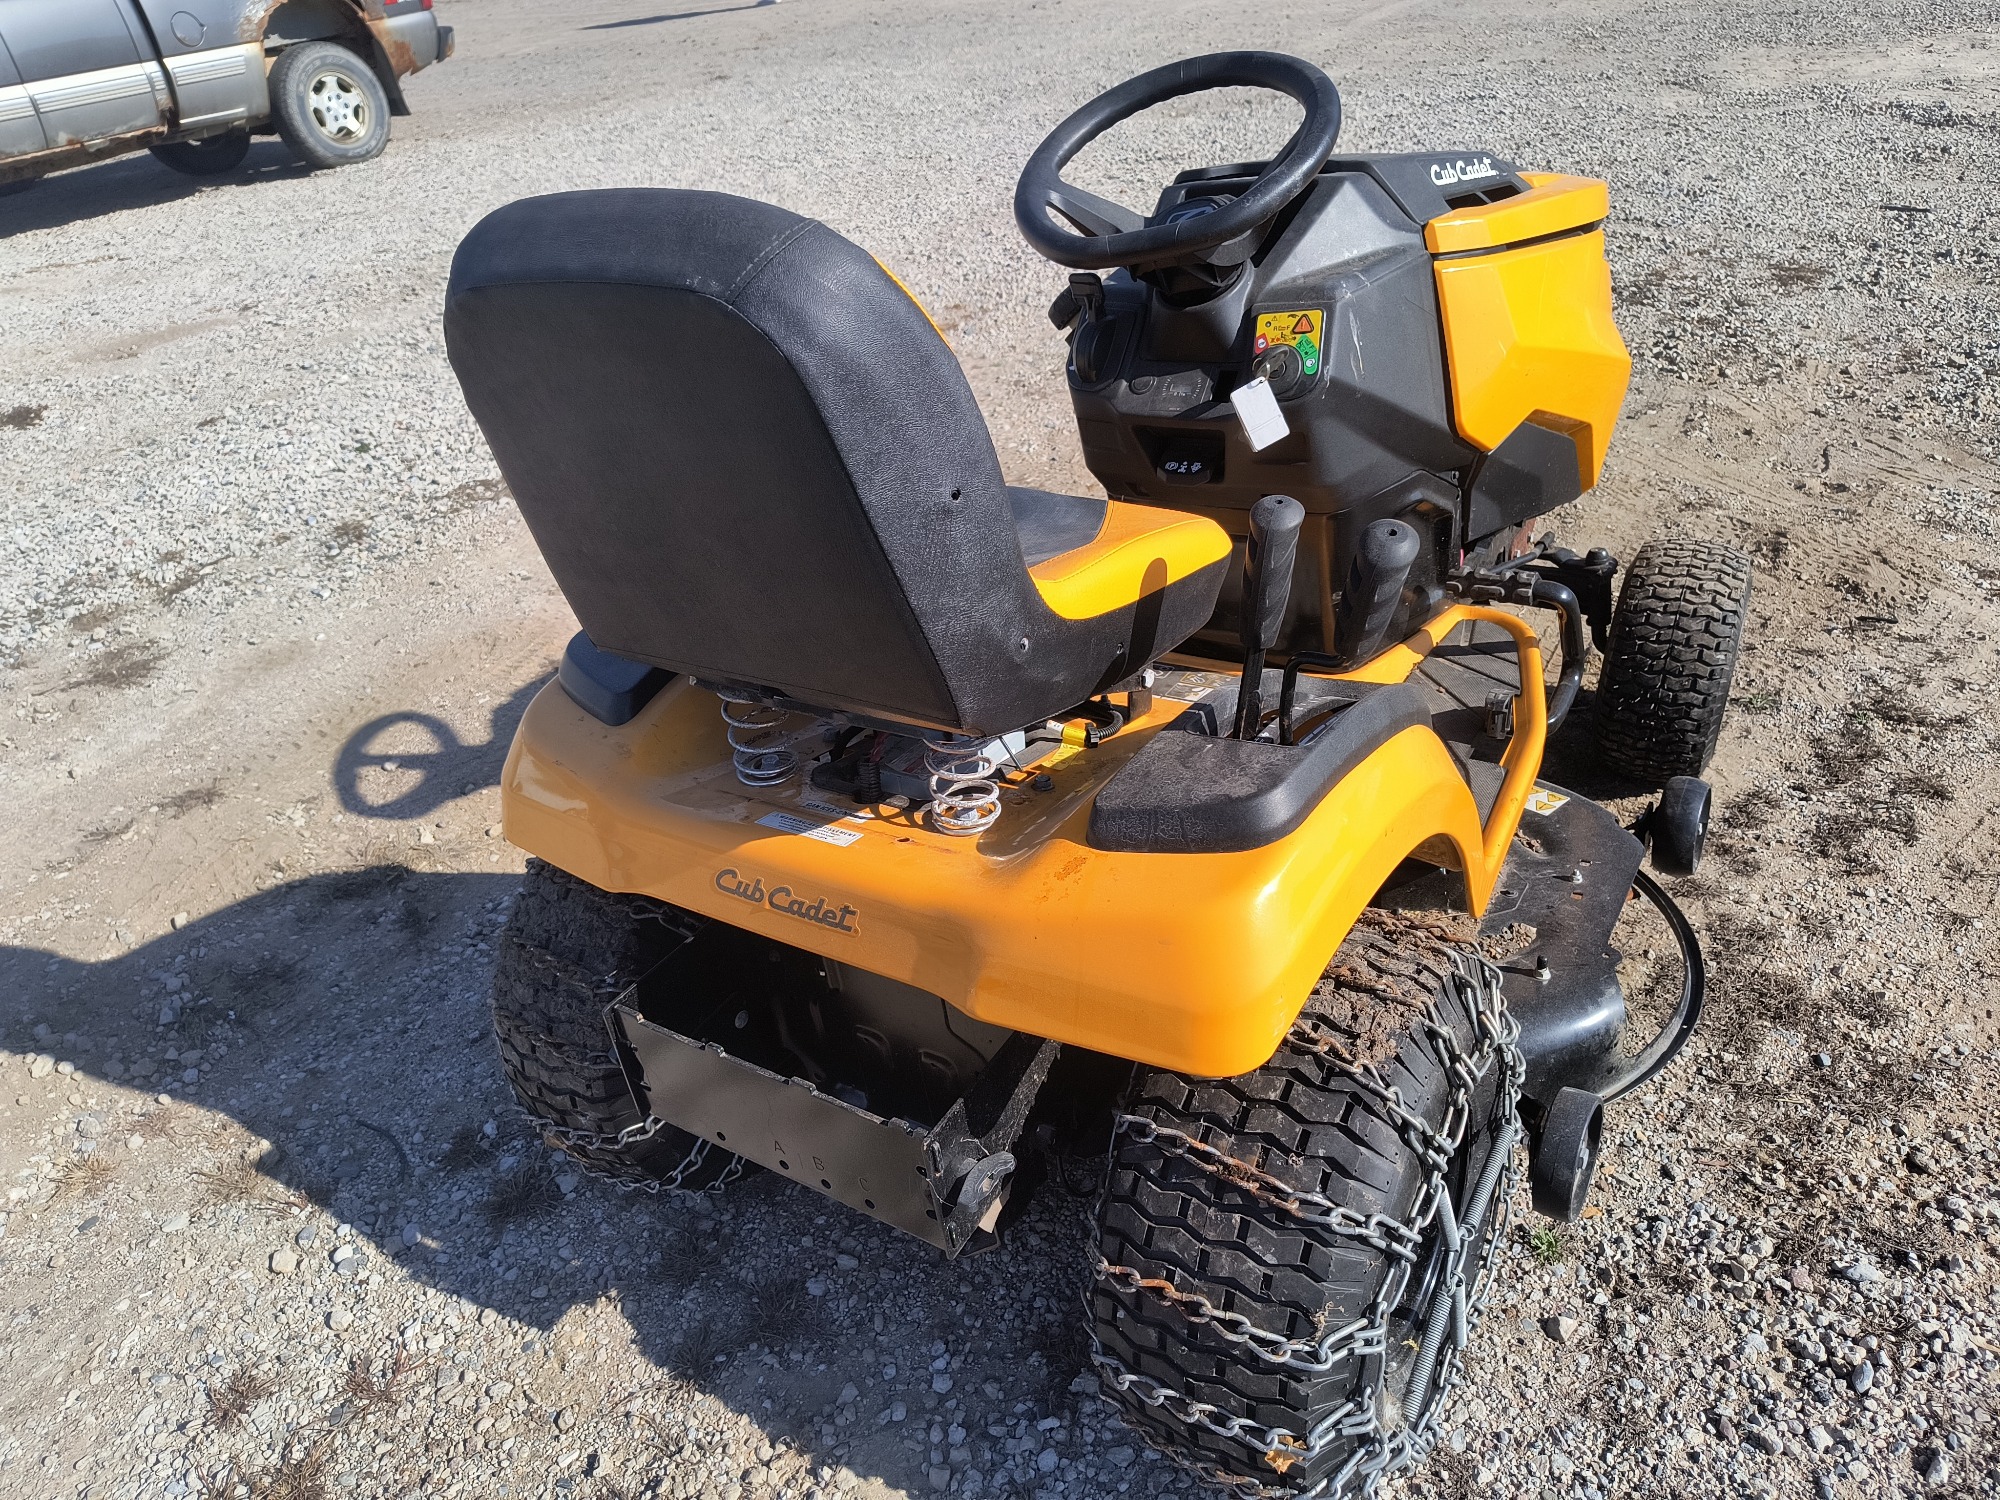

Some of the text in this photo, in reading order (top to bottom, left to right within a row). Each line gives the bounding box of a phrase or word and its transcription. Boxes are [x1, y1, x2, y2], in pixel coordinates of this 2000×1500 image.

[1430, 156, 1498, 186] Cub Cadet
[715, 868, 857, 933] Cub Cadet
[774, 1140, 871, 1193] A B C
